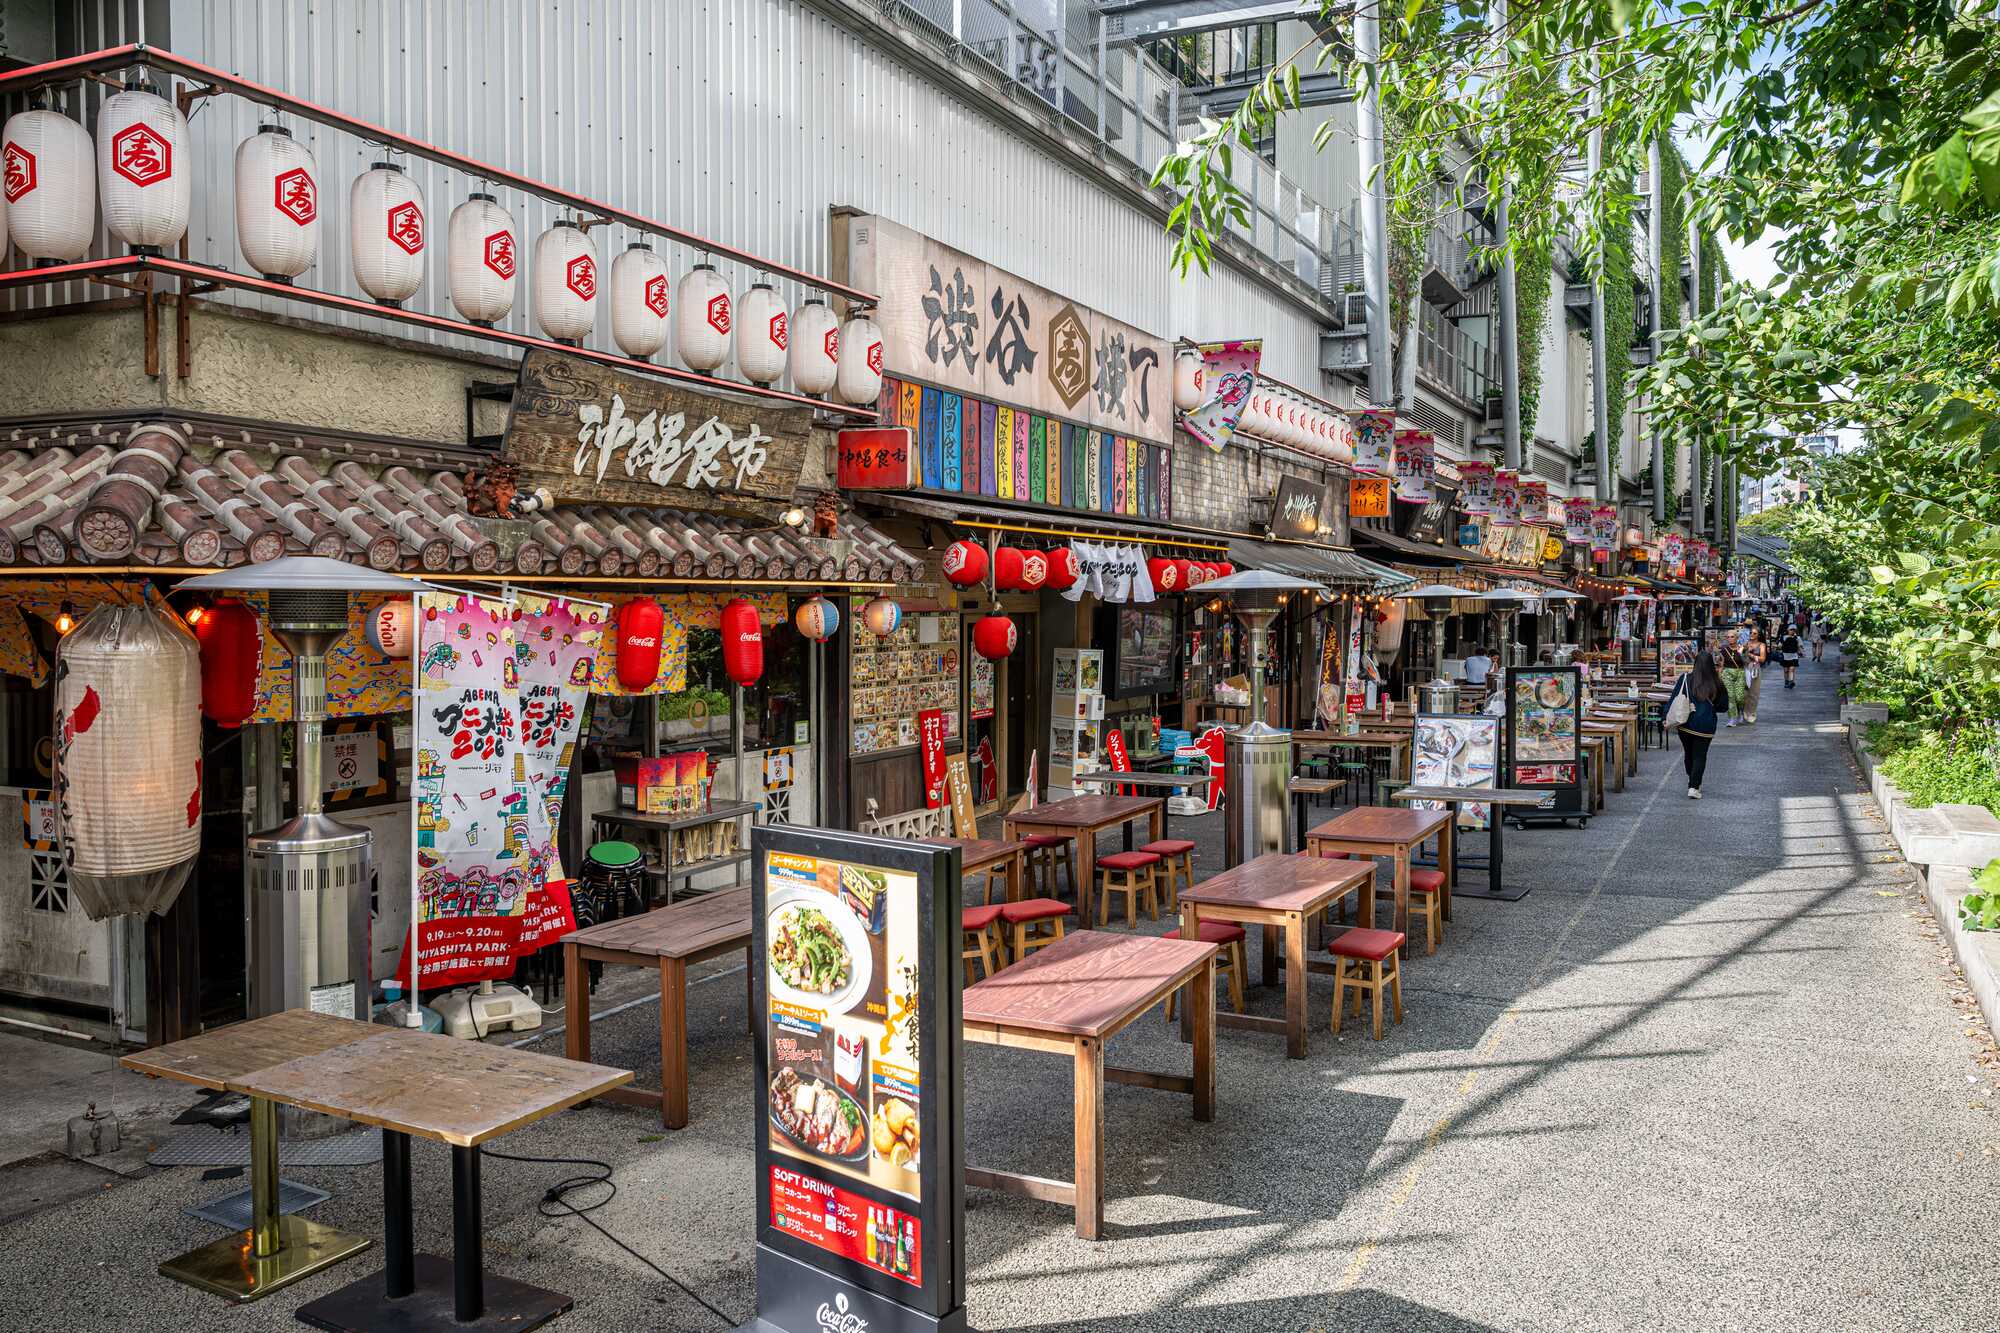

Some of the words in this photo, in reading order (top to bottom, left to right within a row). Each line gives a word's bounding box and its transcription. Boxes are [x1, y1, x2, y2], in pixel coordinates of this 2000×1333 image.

[124, 135, 161, 176] 寿
[286, 176, 313, 215] 寿
[398, 208, 423, 245] 寿
[492, 239, 515, 272] 寿
[574, 263, 596, 292] 寿
[574, 393, 773, 491] 沖縄食市
[840, 447, 906, 469] 沖縄食市
[380, 611, 396, 648] Orion
[627, 635, 655, 648] Coca-Cola
[459, 688, 500, 706] ABEMA
[432, 703, 516, 742] アニメ祭
[450, 730, 505, 761] 2026
[842, 865, 874, 906] SPAM
[774, 1168, 800, 1186] SOFT
[802, 1177, 835, 1198] DRINK
[816, 1302, 869, 1333] Coca-Col
